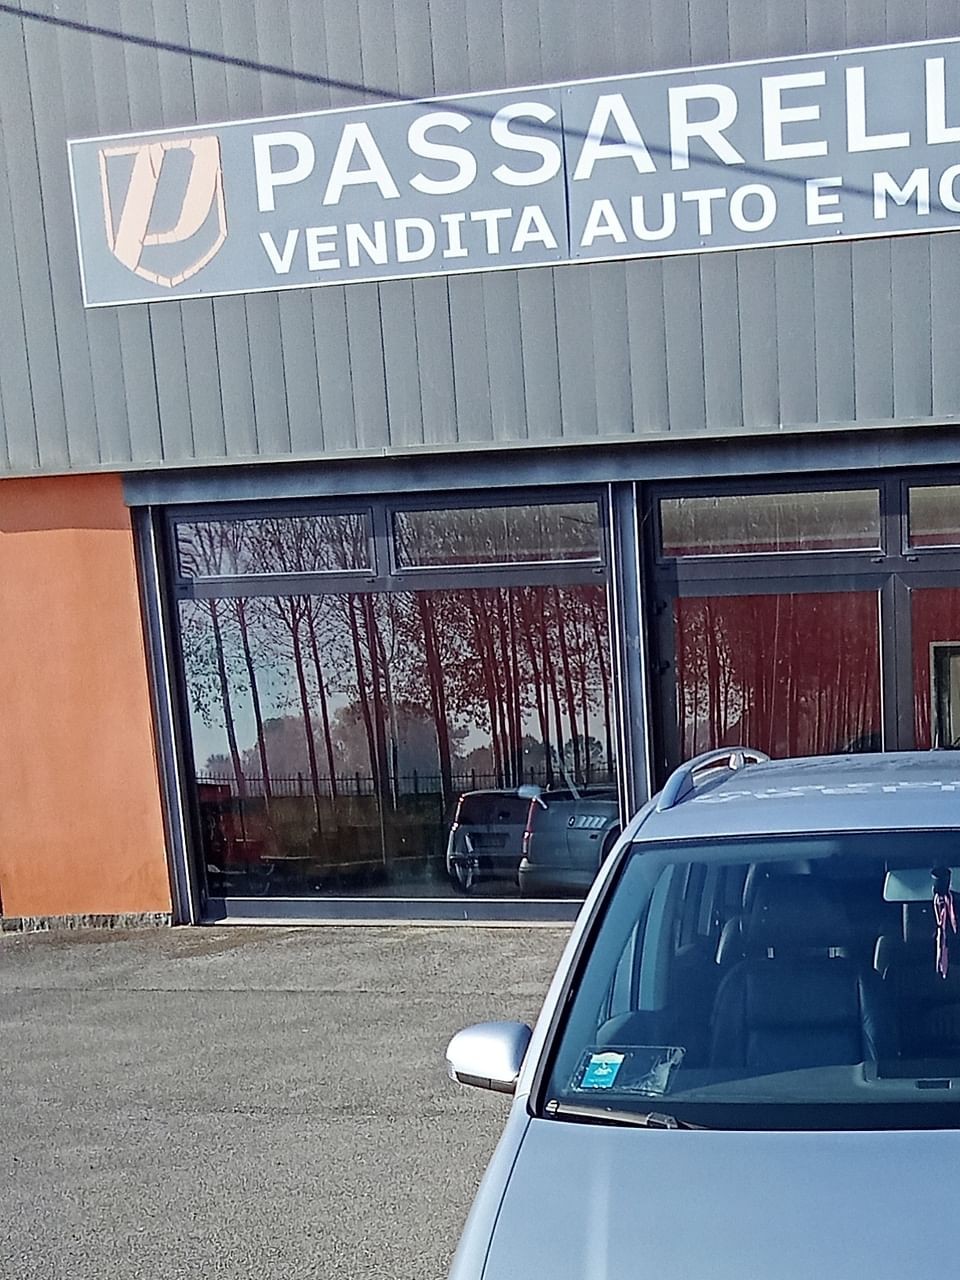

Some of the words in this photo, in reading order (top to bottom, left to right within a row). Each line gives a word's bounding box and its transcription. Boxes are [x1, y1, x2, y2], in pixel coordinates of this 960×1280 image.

[259, 205, 559, 275] VENDITA
[580, 183, 777, 248] AUTO
[805, 176, 844, 226] E
